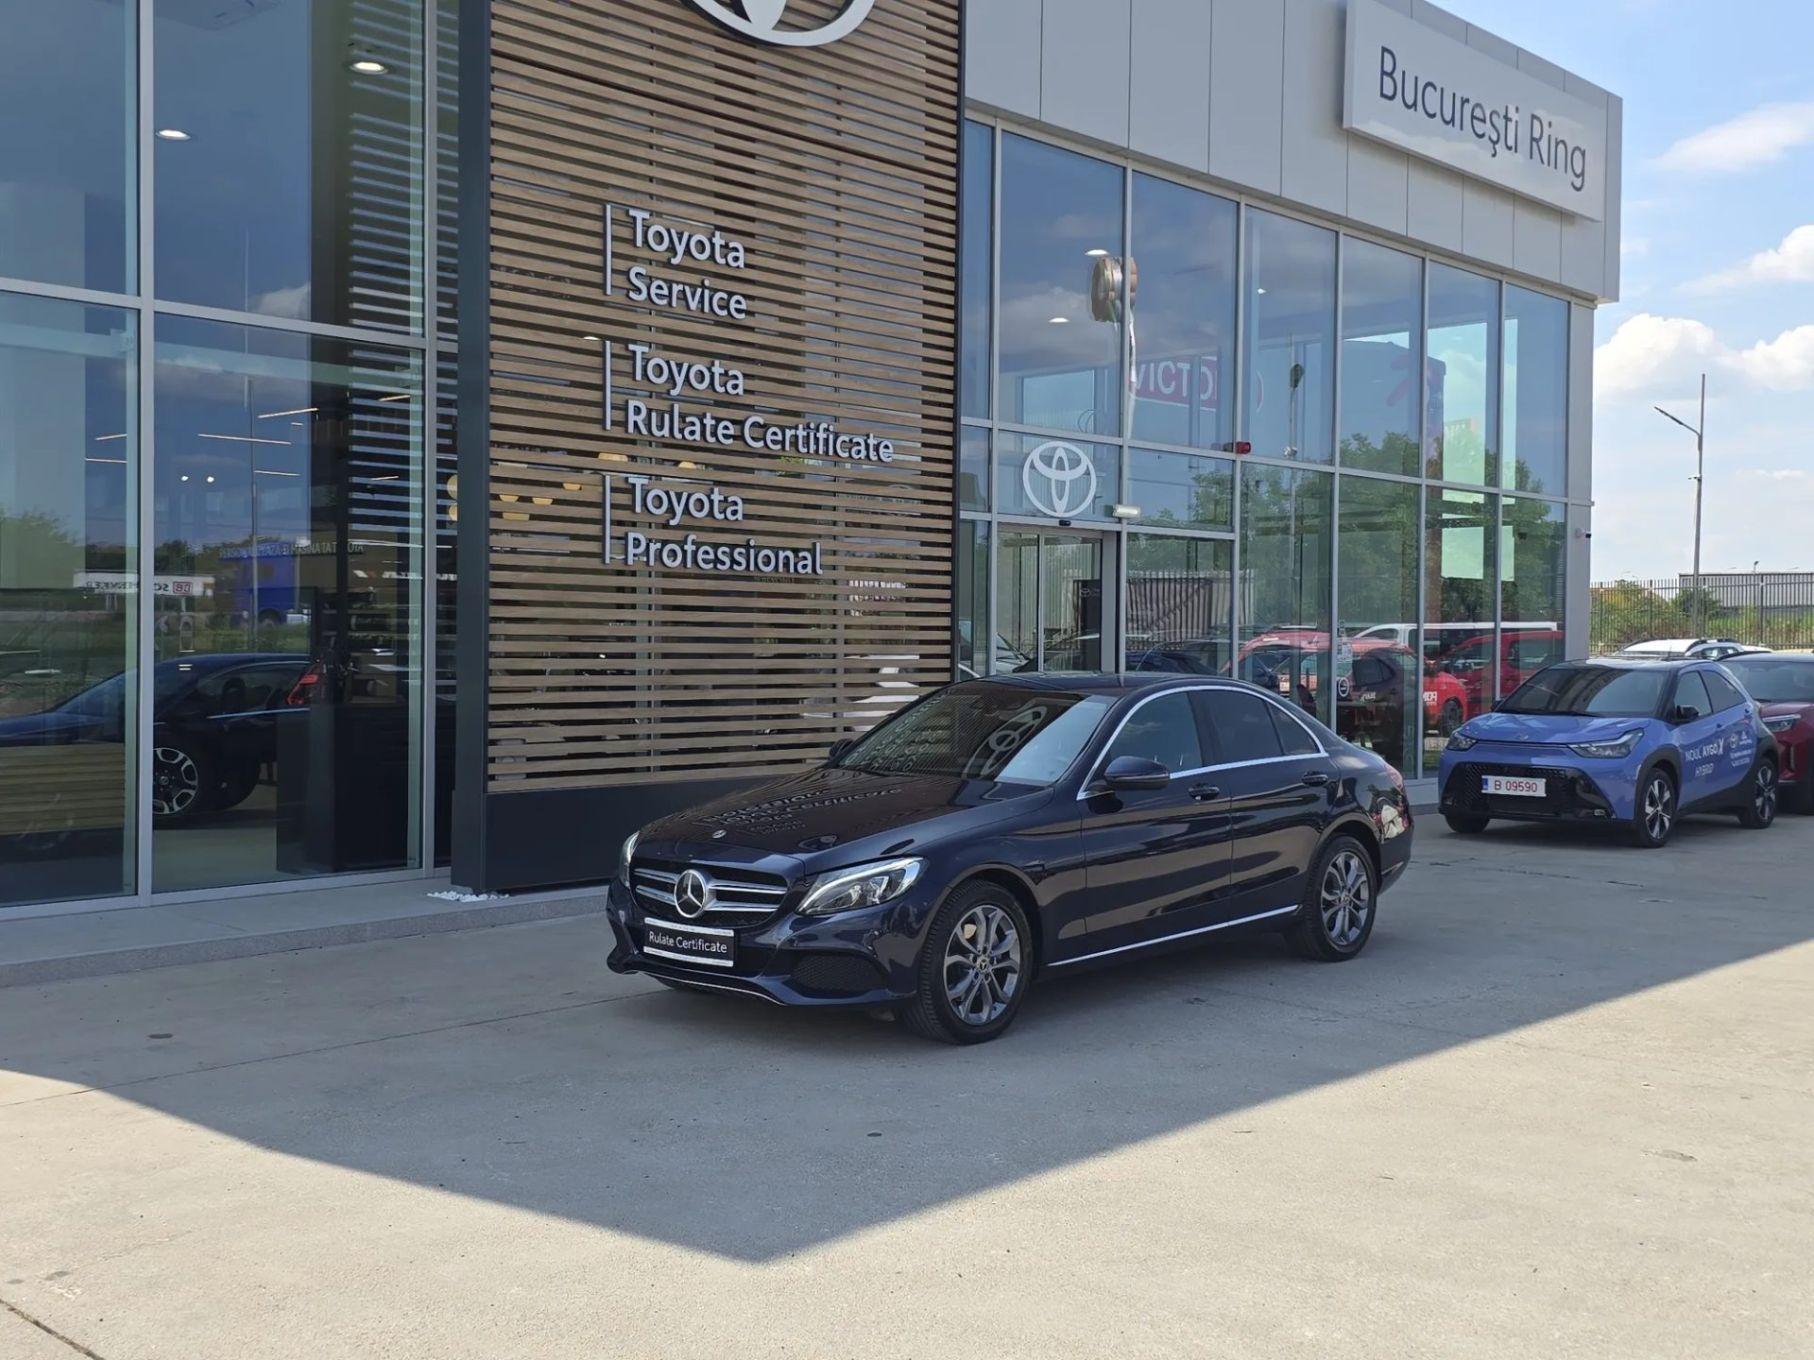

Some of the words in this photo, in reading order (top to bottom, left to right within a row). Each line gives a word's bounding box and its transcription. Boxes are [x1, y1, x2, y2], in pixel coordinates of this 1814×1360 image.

[1529, 113, 1586, 192] Ring
[628, 207, 746, 269] Toyota
[628, 266, 747, 320] Service
[628, 343, 744, 397] Toyota
[626, 399, 734, 446] Rulate
[743, 415, 895, 463] Certificate
[628, 476, 743, 526] Toyota
[626, 531, 823, 576] Professional
[1494, 780, 1502, 791] B
[1505, 781, 1538, 792] 09590
[649, 930, 675, 947] Rulate
[676, 936, 728, 953] Certificate
